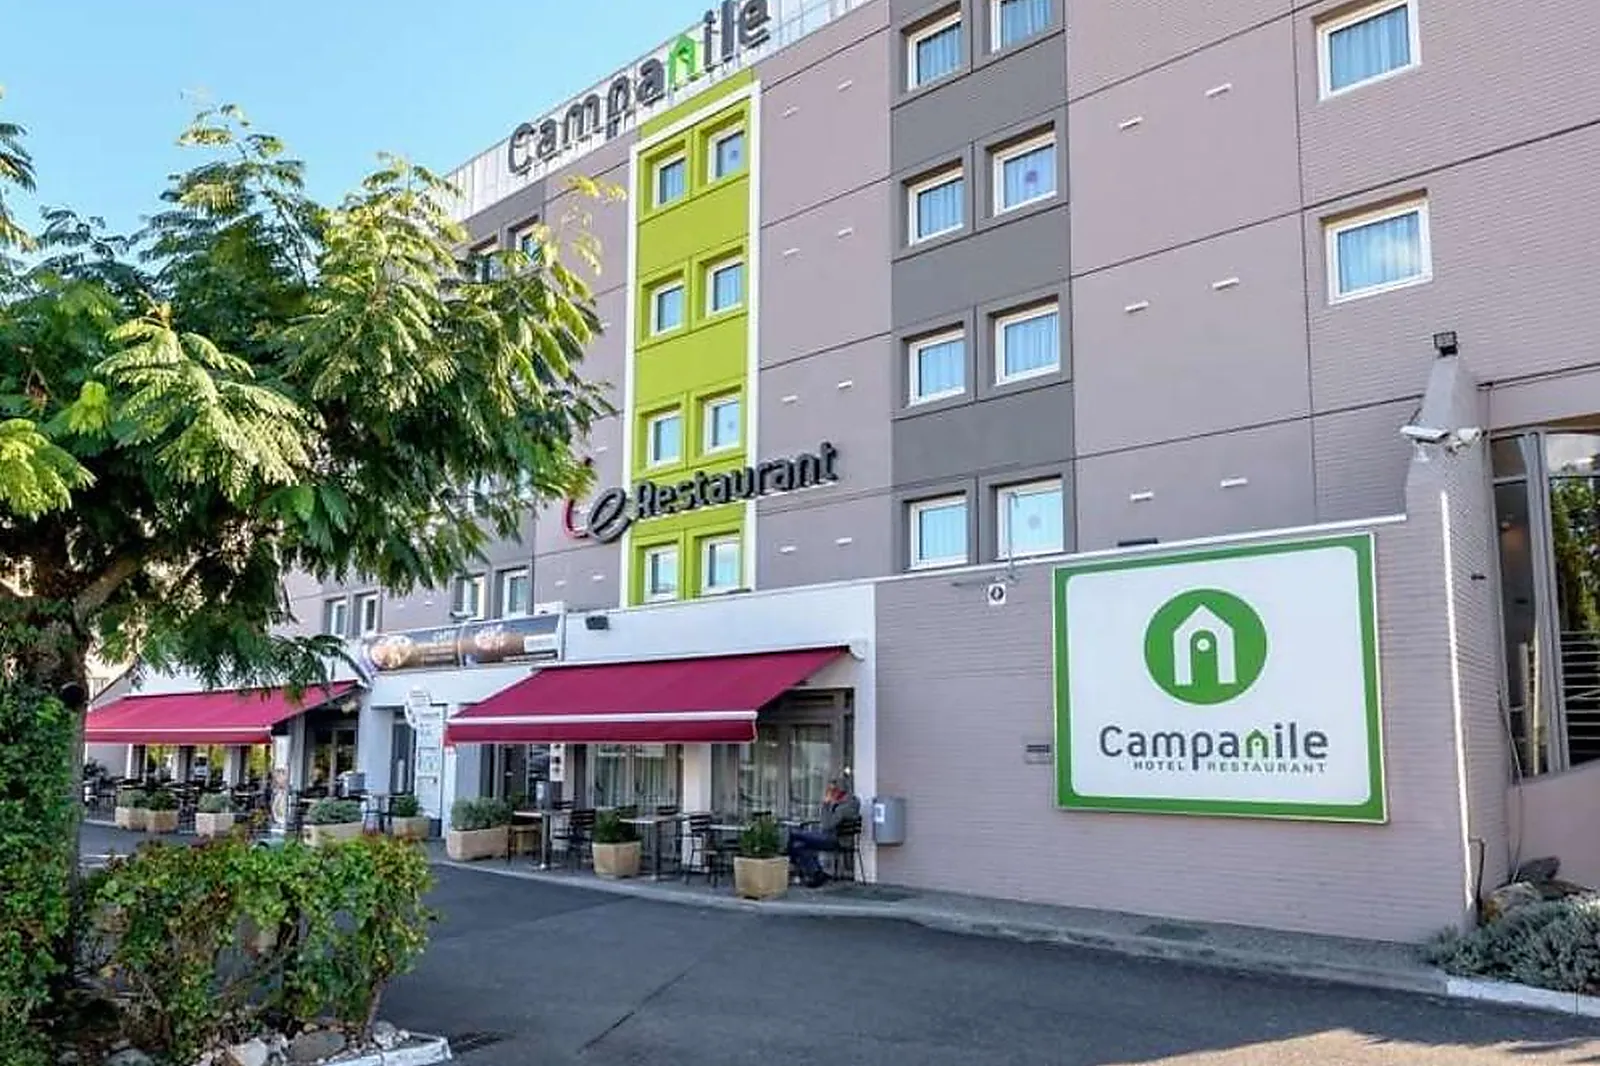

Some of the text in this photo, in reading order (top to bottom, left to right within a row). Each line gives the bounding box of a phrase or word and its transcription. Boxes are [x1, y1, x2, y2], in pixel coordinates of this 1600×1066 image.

[508, 0, 771, 177] Campanile
[636, 441, 839, 520] Restaurant
[1099, 722, 1328, 771] Campanile
[1133, 760, 1327, 773] HOTEL RESTAURANT
